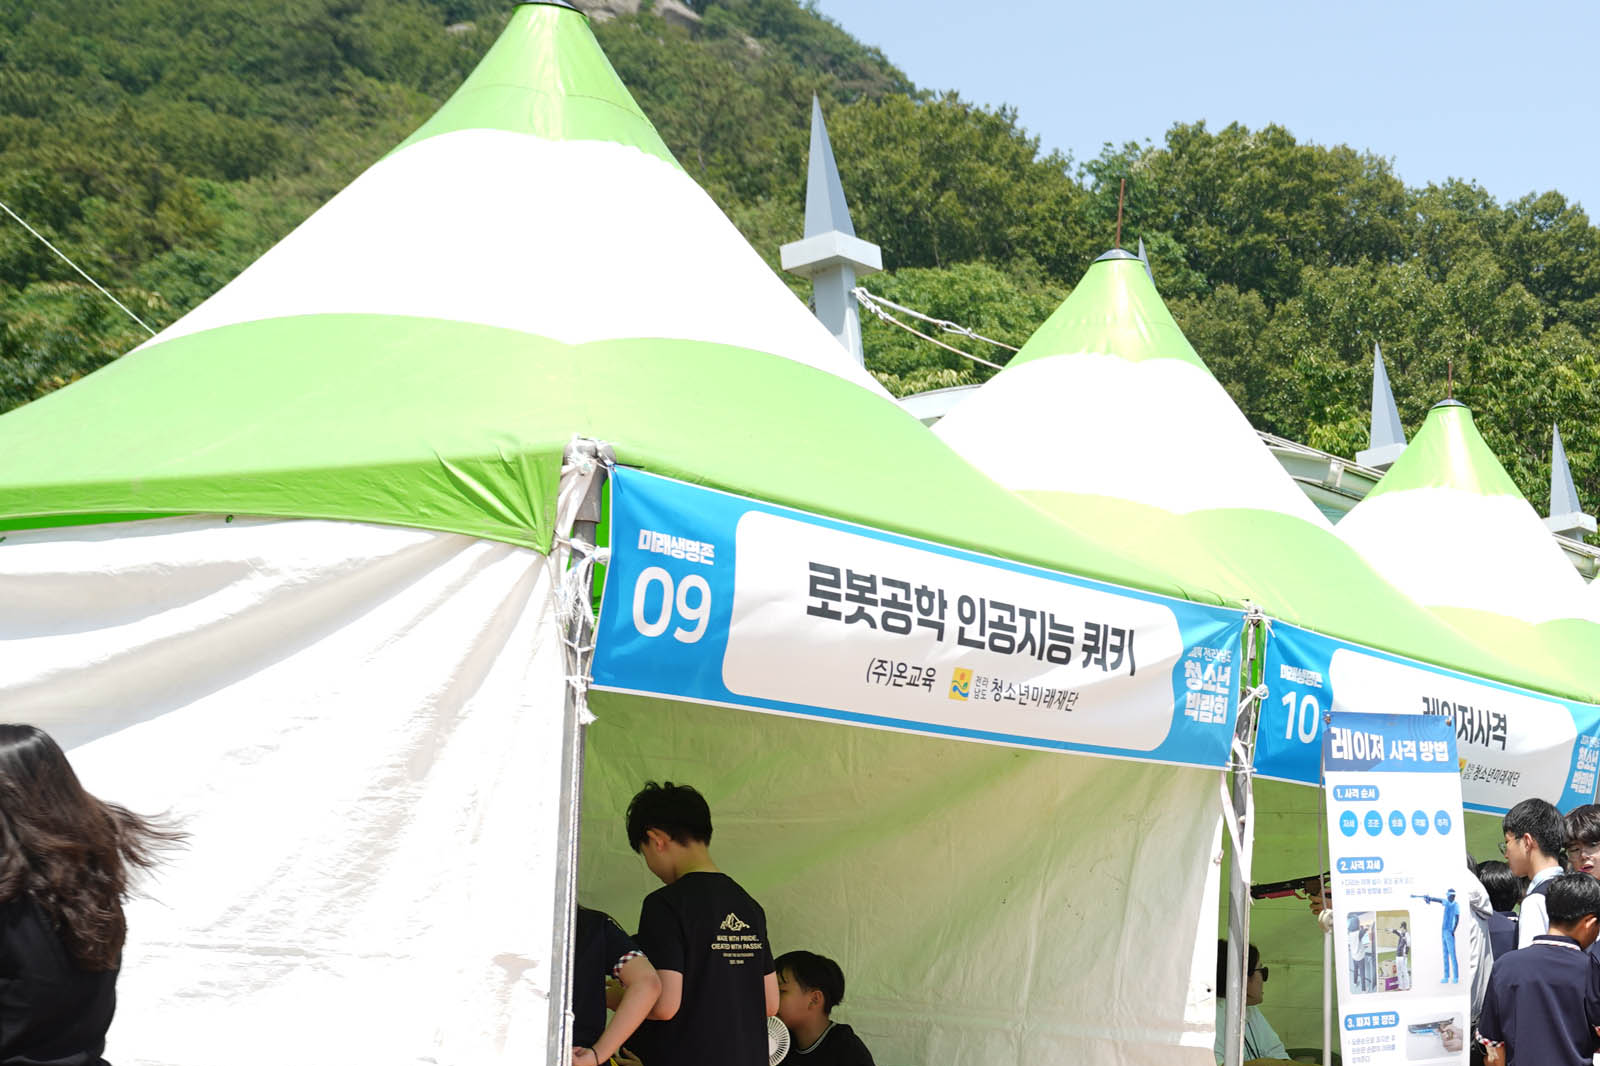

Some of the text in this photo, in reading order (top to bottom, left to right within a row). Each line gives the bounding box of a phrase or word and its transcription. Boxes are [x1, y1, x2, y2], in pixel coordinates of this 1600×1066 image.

[638, 529, 715, 566] 미래생명존
[632, 566, 712, 644] 09
[806, 561, 1136, 677] 로봇공학 인공지능 쿼키
[866, 657, 937, 693] (주)온교육
[1184, 659, 1231, 695] 청소년
[990, 678, 1079, 712] 청소년미래재단
[1184, 691, 1229, 725] 박람회
[1281, 691, 1320, 744] 10
[1331, 726, 1449, 762] 레이저 사격 방법
